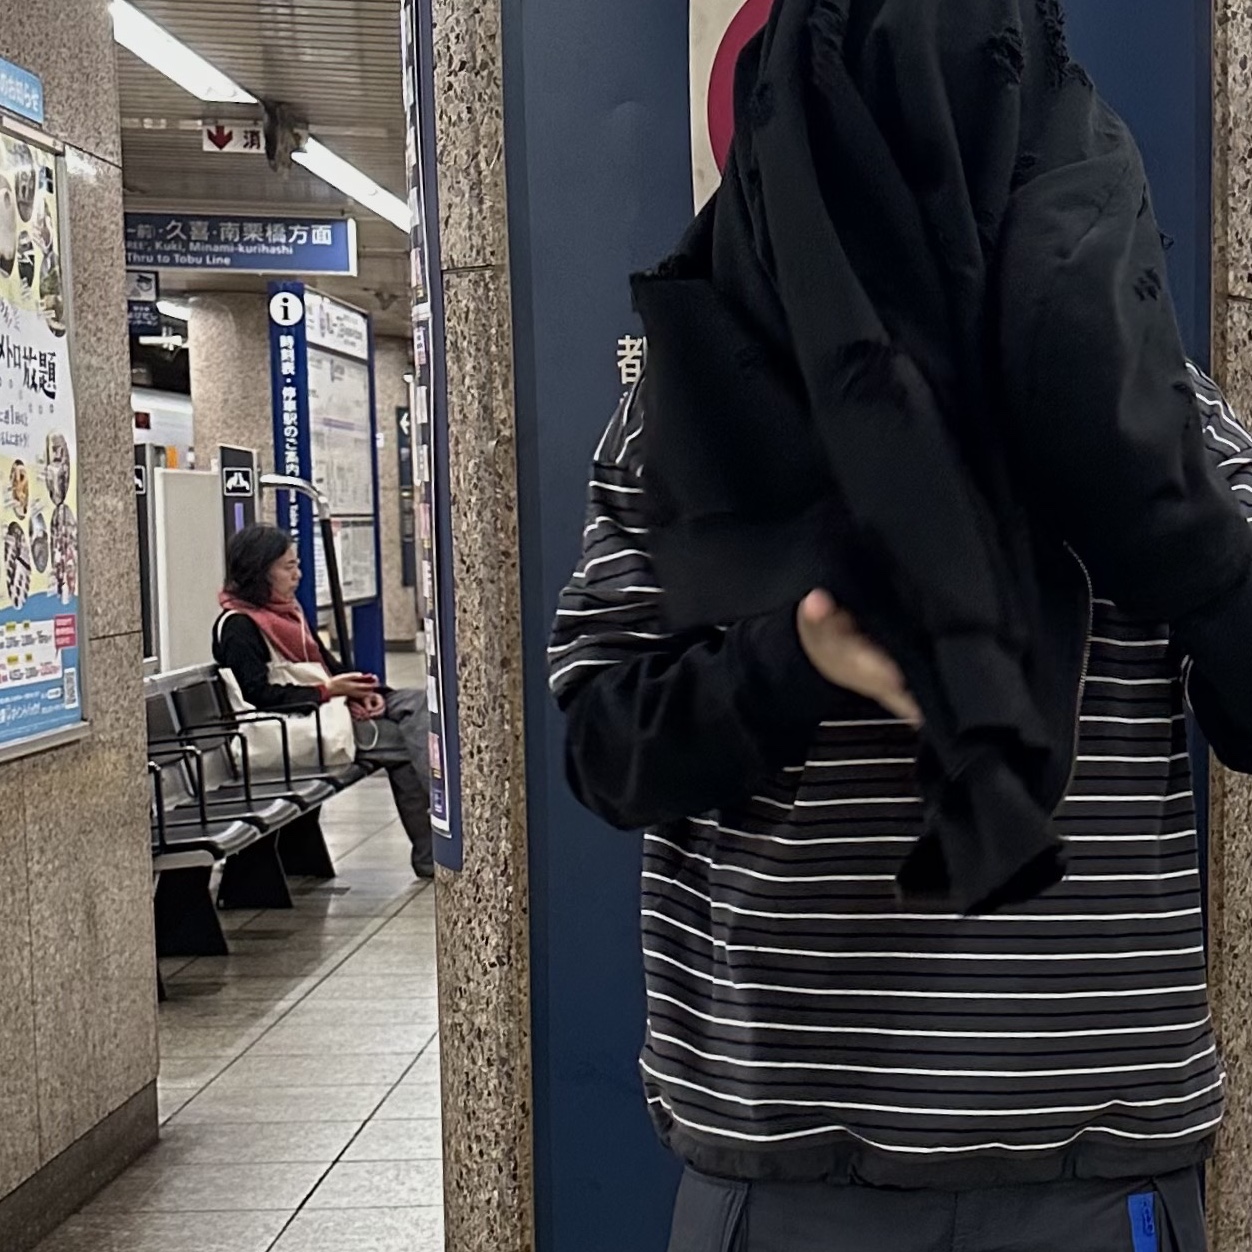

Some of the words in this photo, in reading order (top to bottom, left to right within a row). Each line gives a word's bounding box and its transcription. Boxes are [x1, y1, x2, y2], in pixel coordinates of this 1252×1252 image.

[155, 240, 186, 252] Kuki,
[189, 242, 294, 256] Minami-kurihashi
[127, 252, 154, 264] Thru
[157, 253, 171, 264] to
[174, 254, 203, 265] Tobu
[206, 254, 231, 266] Line
[617, 334, 649, 404] 都
